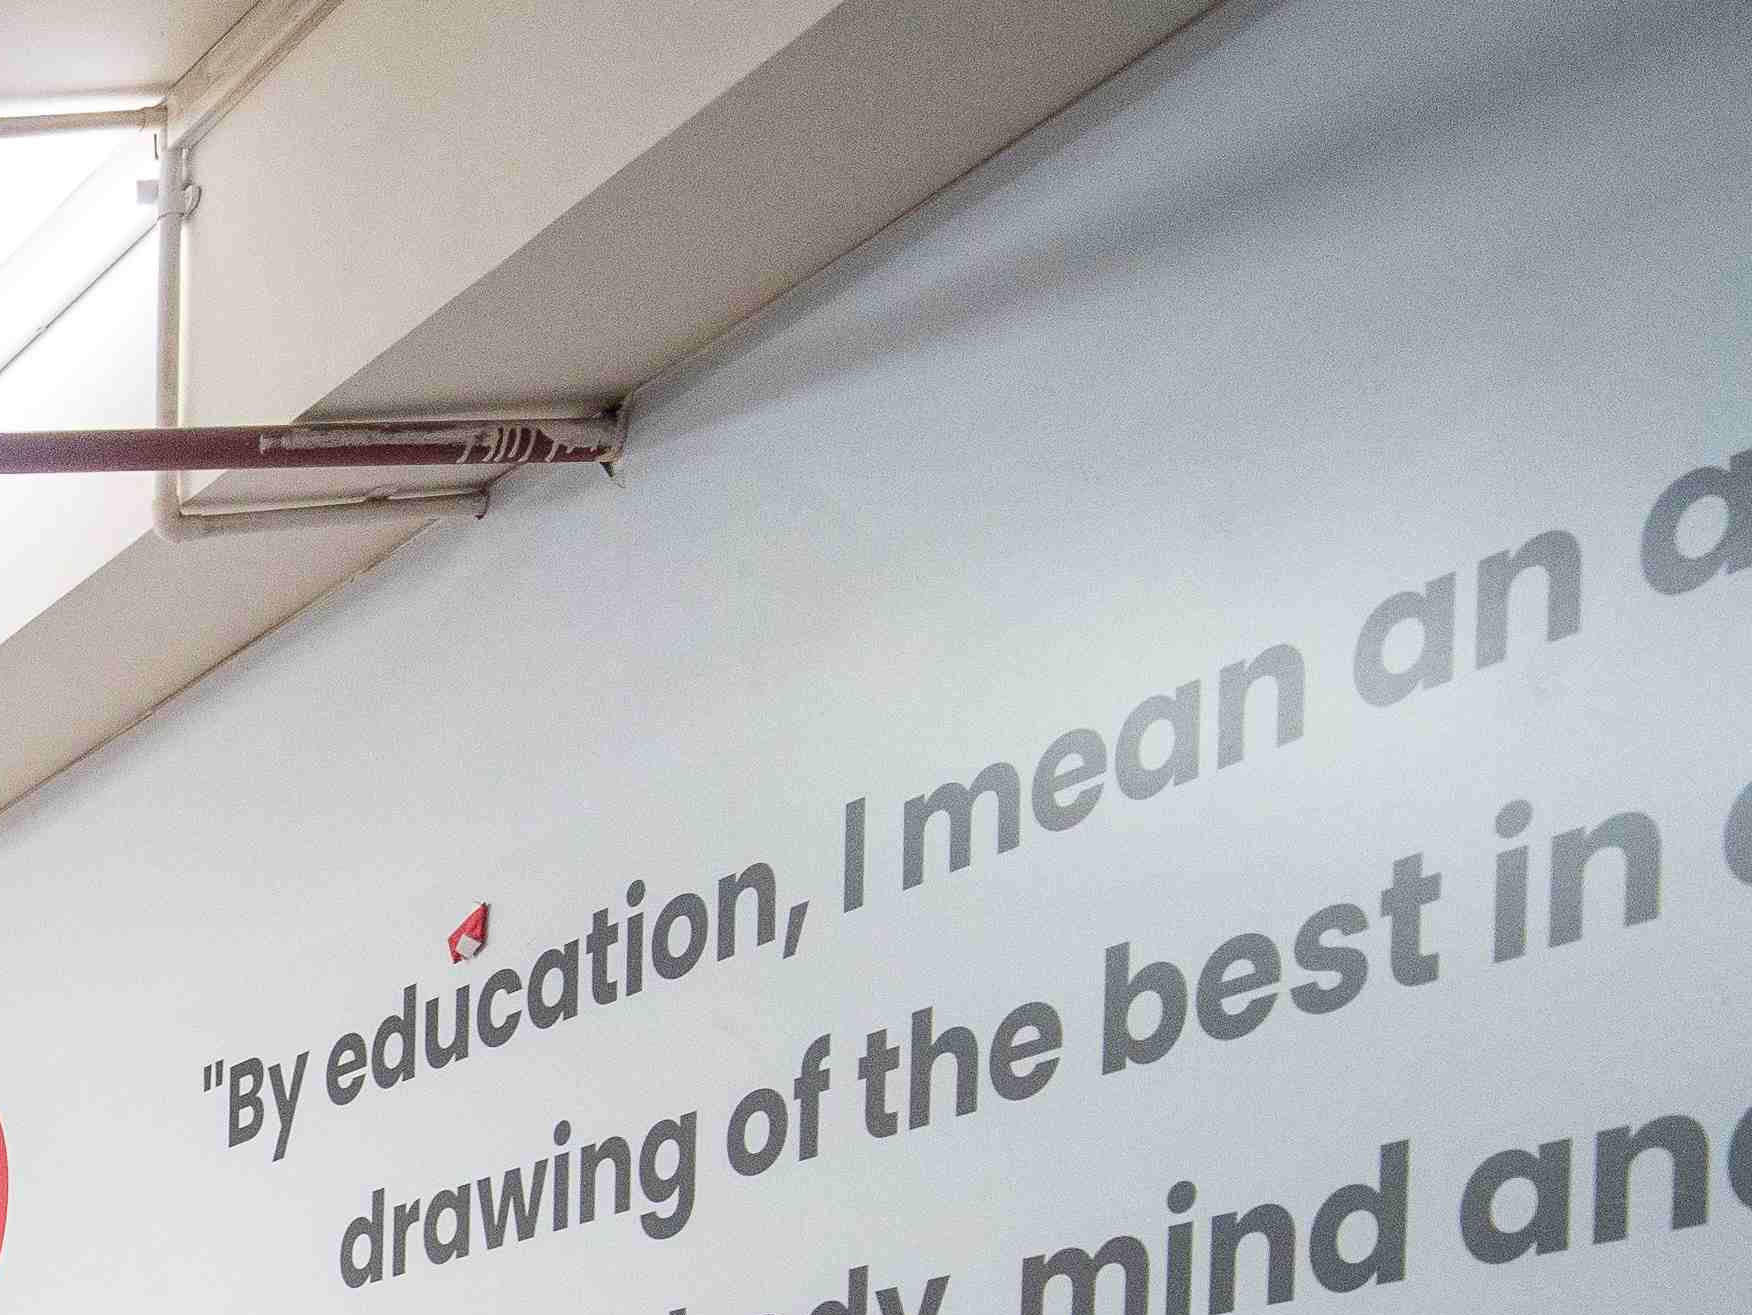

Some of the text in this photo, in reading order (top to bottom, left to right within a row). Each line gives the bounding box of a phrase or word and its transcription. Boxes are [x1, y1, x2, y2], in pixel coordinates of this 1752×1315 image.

[204, 1051, 309, 1162] "By
[326, 863, 809, 1105] education,
[844, 798, 865, 913] I
[902, 643, 1307, 892] mean
[1352, 530, 1582, 708] an
[340, 1111, 697, 1288] drawing
[727, 1034, 830, 1176] of
[858, 1002, 1062, 1138] the
[1102, 854, 1440, 1075] best
[1494, 801, 1660, 963] in
